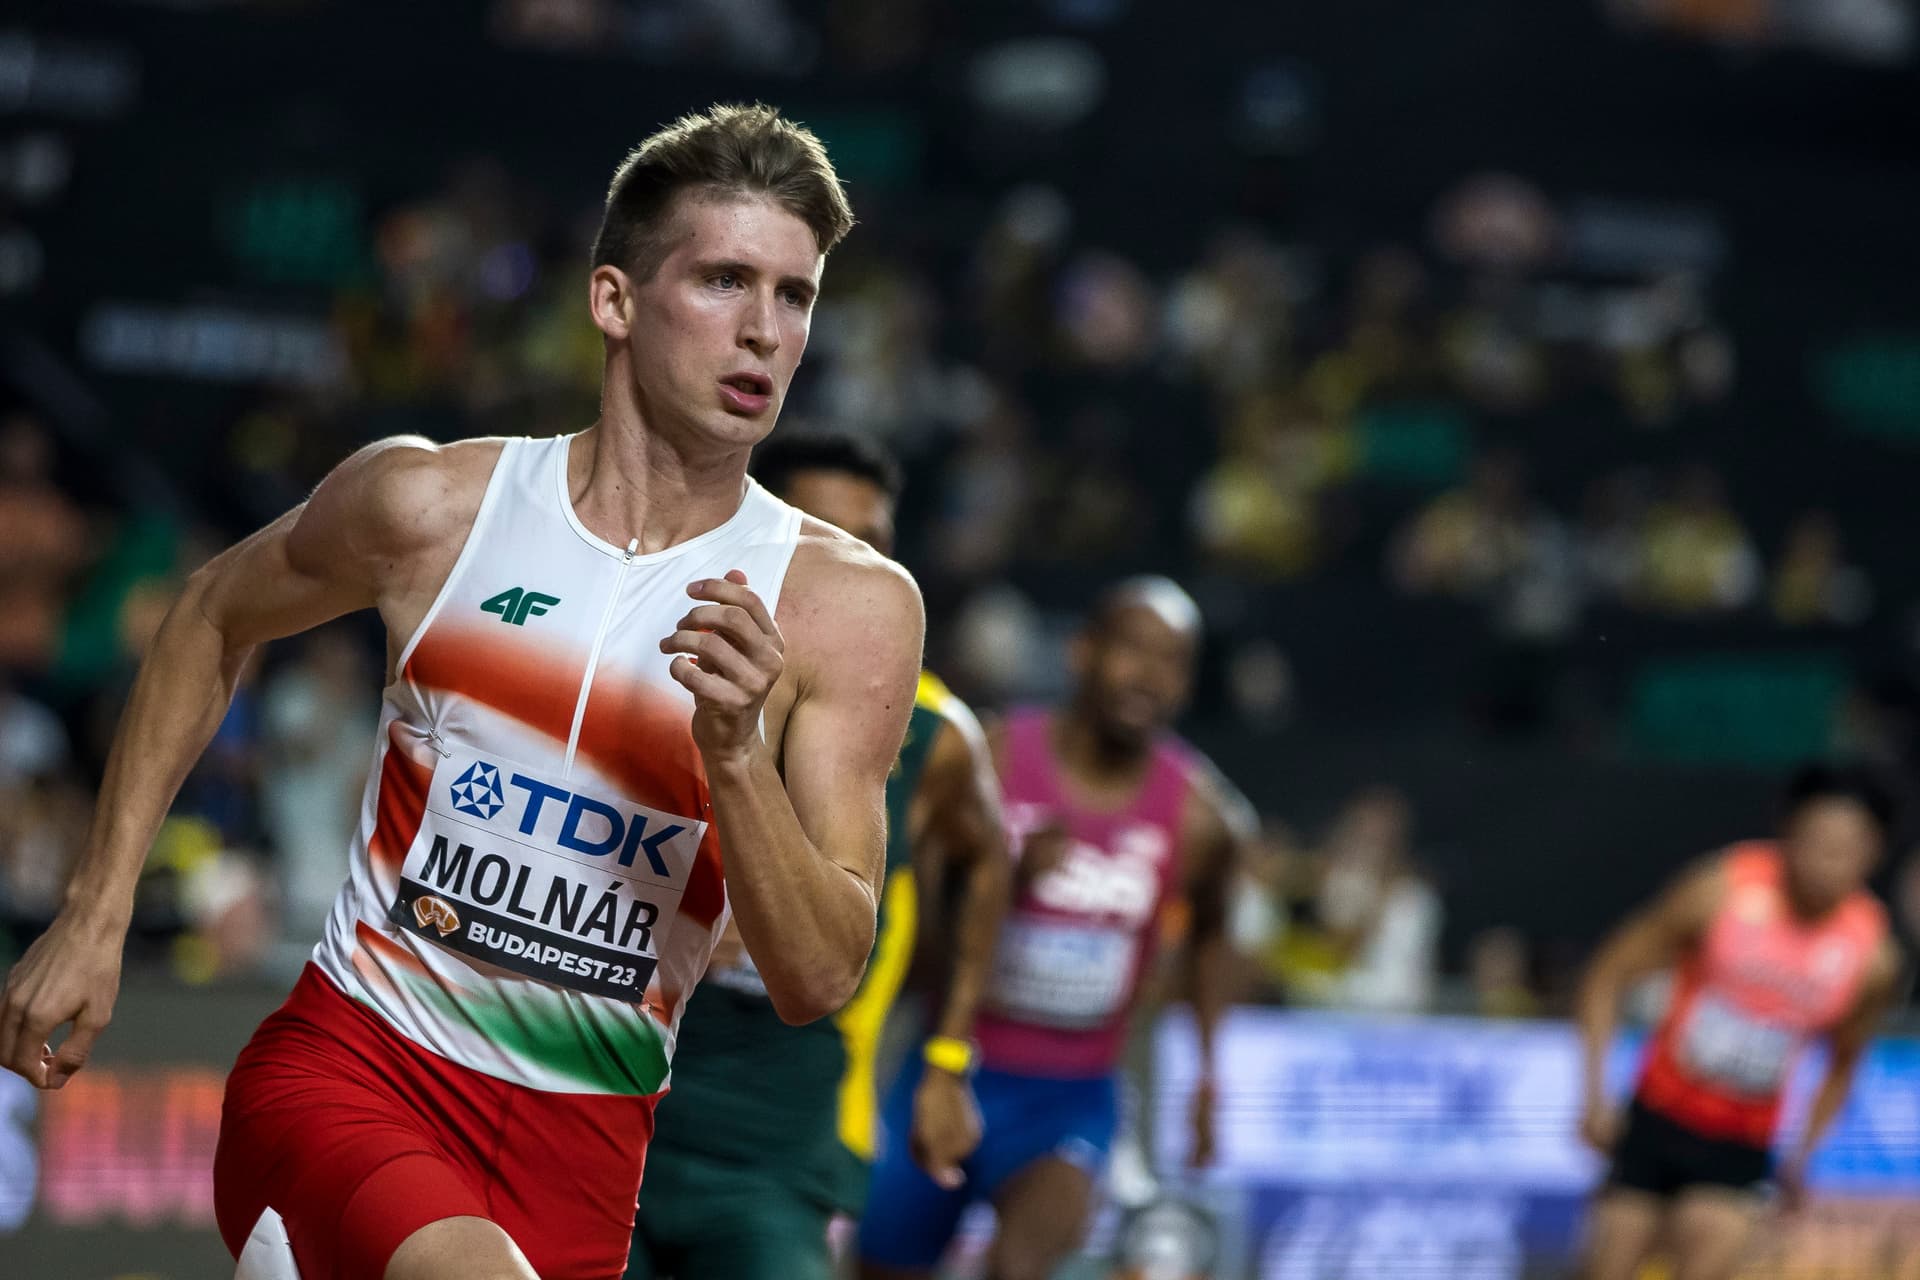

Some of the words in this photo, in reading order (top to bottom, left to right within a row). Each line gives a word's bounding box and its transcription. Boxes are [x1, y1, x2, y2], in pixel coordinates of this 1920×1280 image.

[480, 586, 561, 626] 4F
[510, 773, 686, 878] TDK
[419, 834, 659, 952] MOLNÁR
